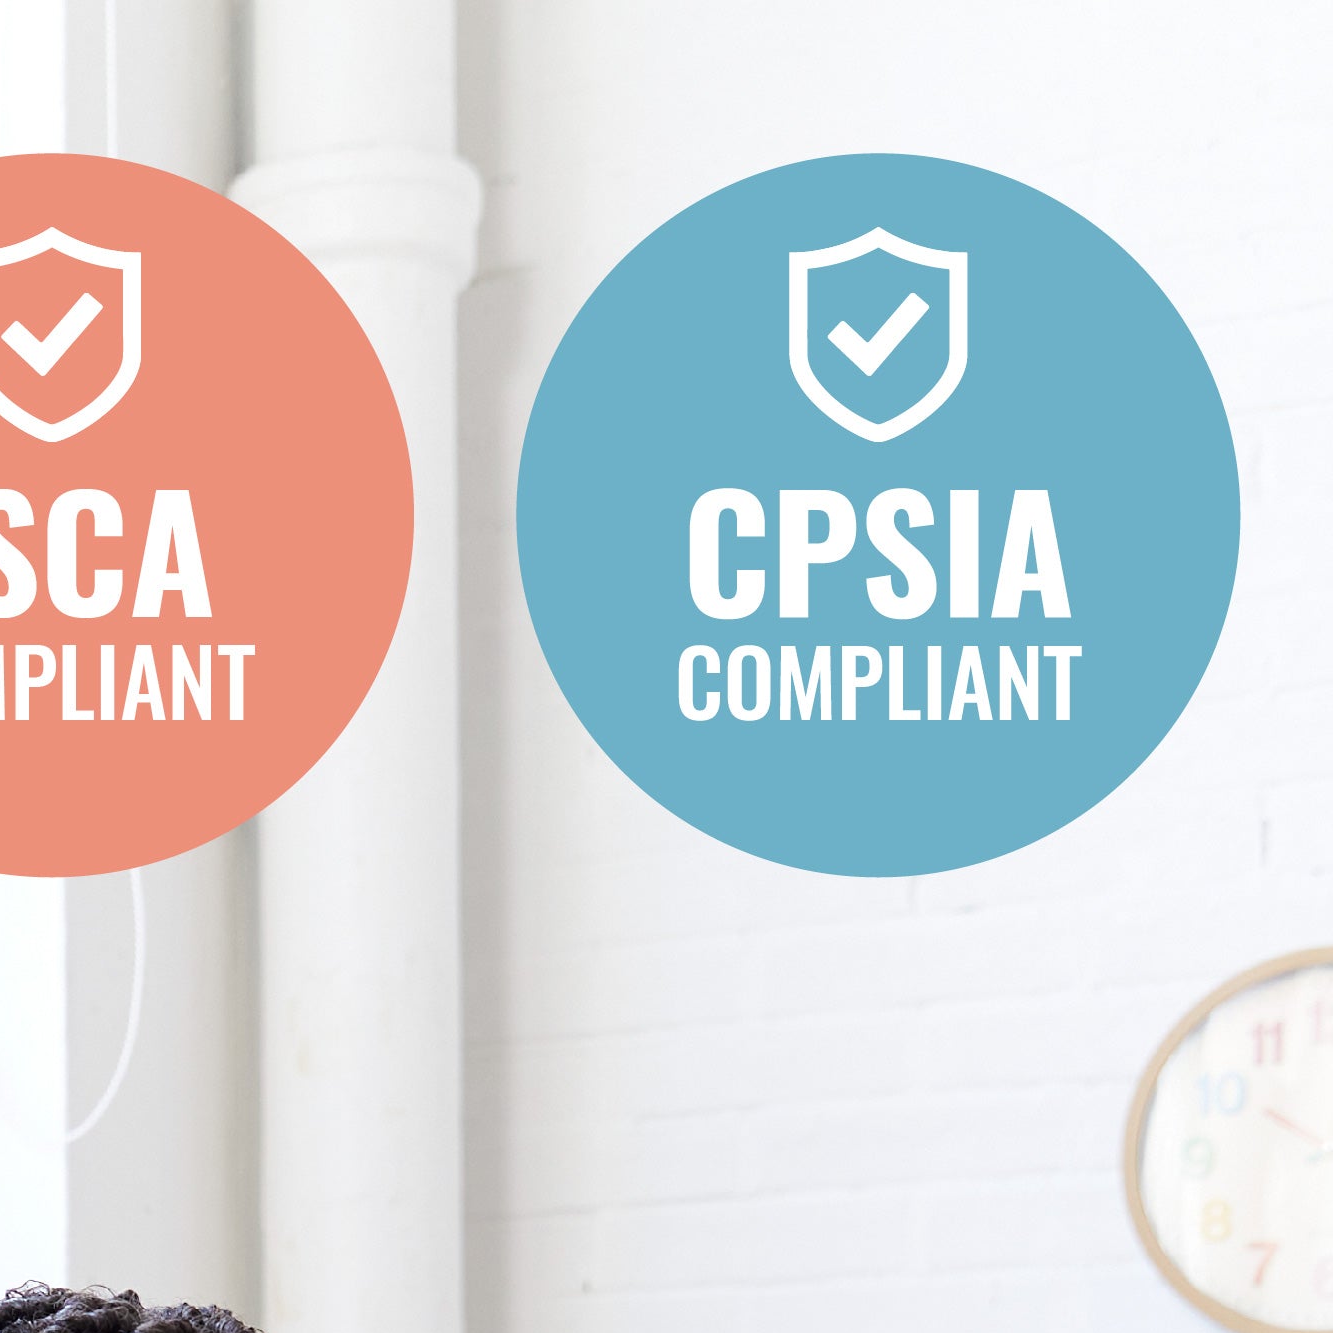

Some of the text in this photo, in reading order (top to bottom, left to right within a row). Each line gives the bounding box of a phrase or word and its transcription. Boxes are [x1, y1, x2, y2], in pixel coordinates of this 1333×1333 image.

[1252, 1020, 1285, 1066] 11
[1198, 1071, 1247, 1117] 10
[1181, 1136, 1214, 1179] 9
[1199, 1200, 1233, 1244] 8
[1246, 1241, 1279, 1287] 7
